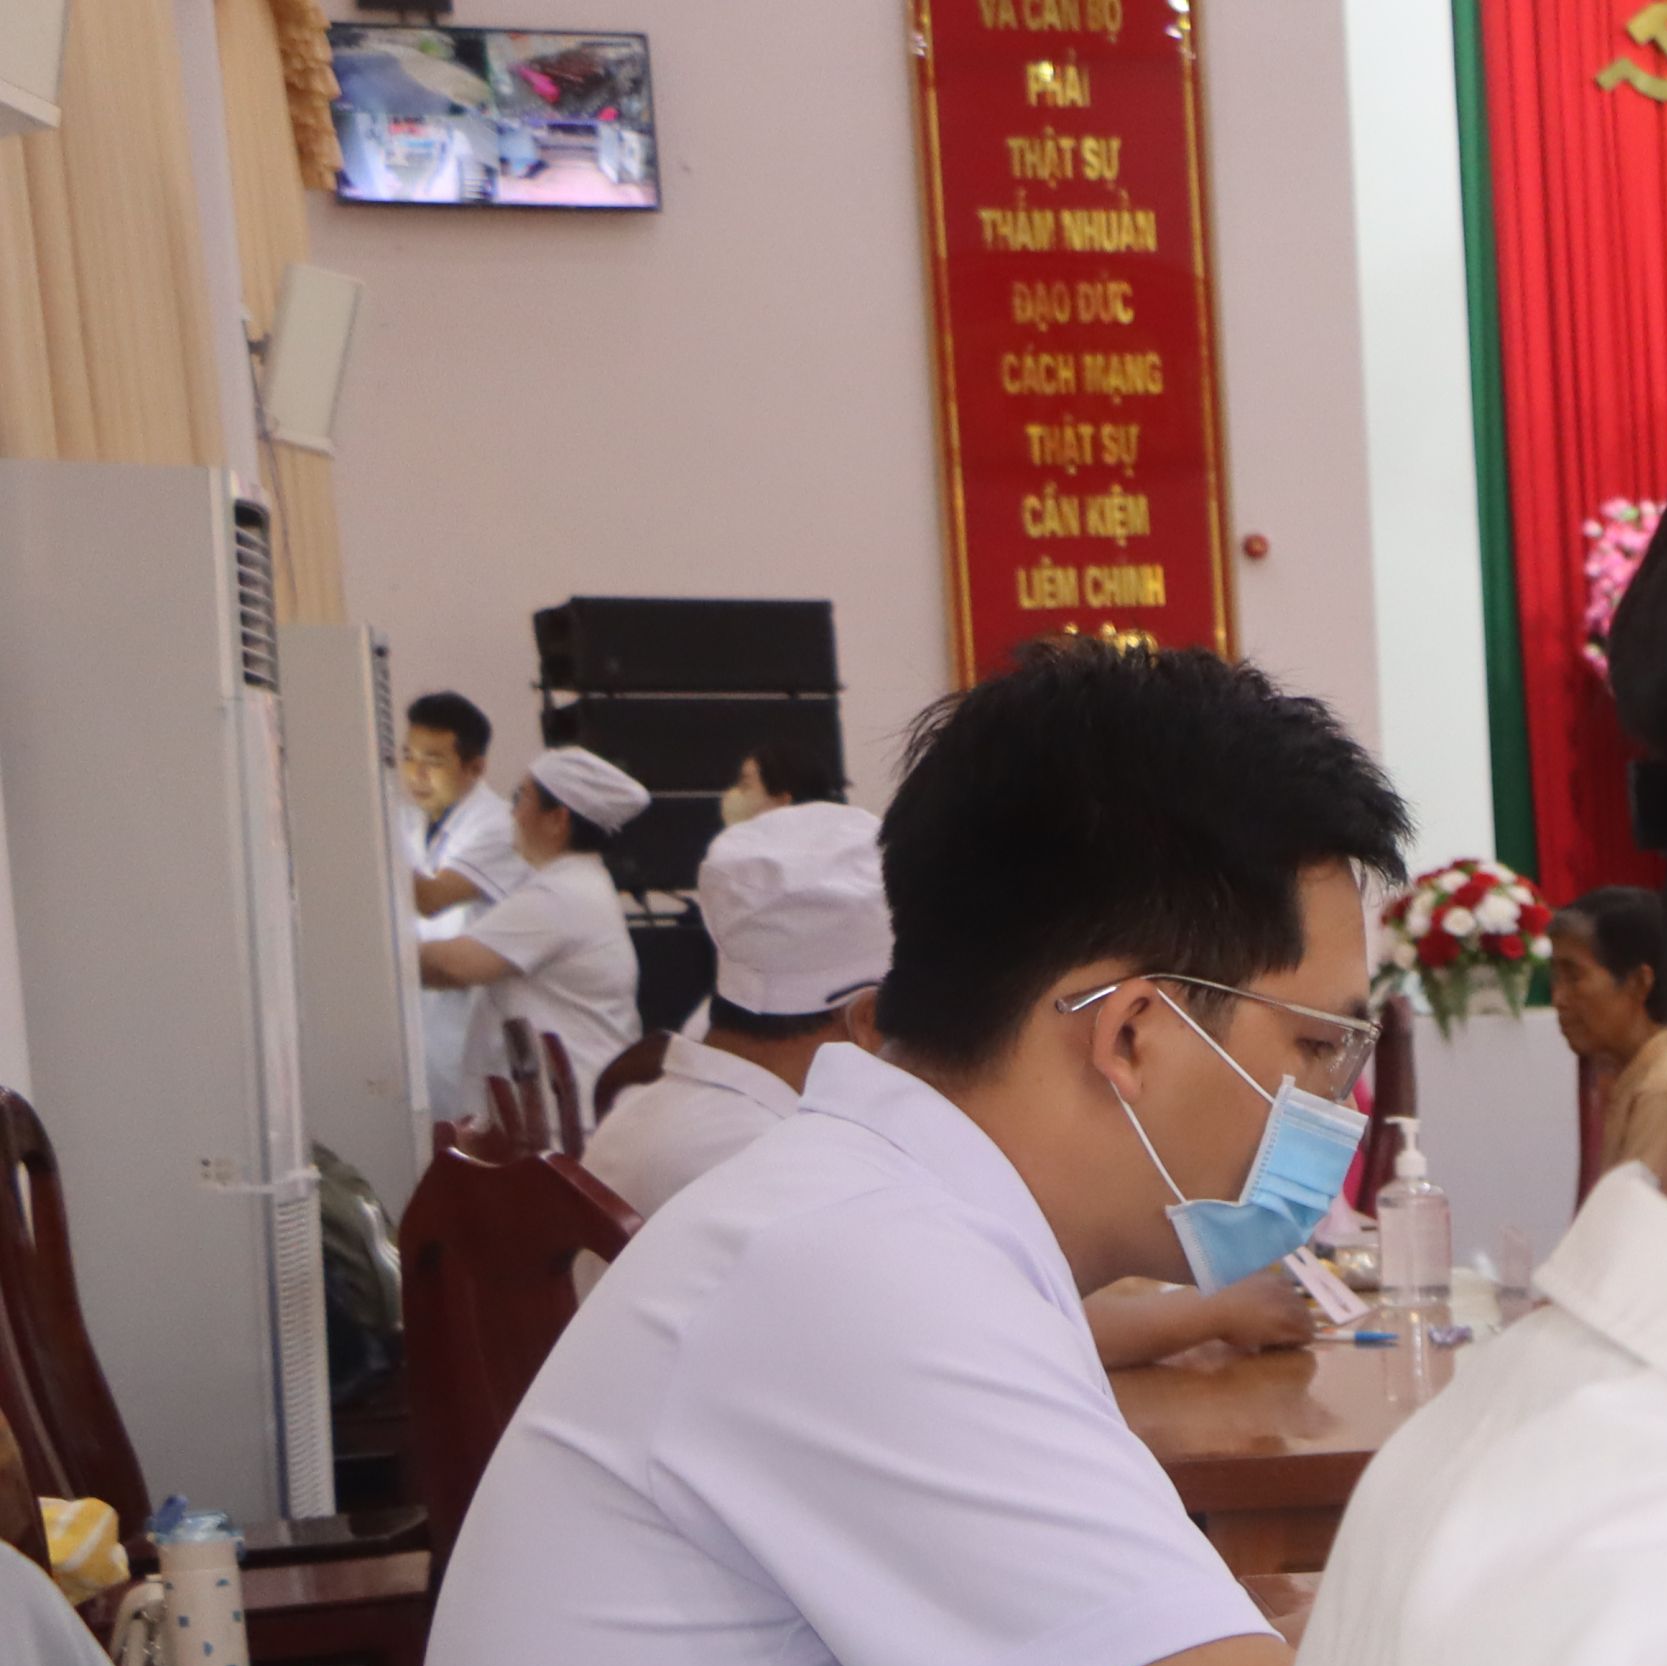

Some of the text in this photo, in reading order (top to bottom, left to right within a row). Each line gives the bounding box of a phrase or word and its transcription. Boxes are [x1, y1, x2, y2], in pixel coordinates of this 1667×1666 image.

[1026, 48, 1090, 107] PHẢI
[1006, 126, 1121, 190] THẬT SỰ
[1061, 187, 1157, 252] NHUẦN
[1011, 273, 1134, 332] ĐẠO ĐỨC
[1002, 344, 1163, 405] CÁCH MẠNG
[1025, 414, 1140, 477] THẬT SỰ
[1022, 480, 1150, 547] CẦN KIỆM
[1016, 555, 1166, 610] LIÊM CHÍNH
